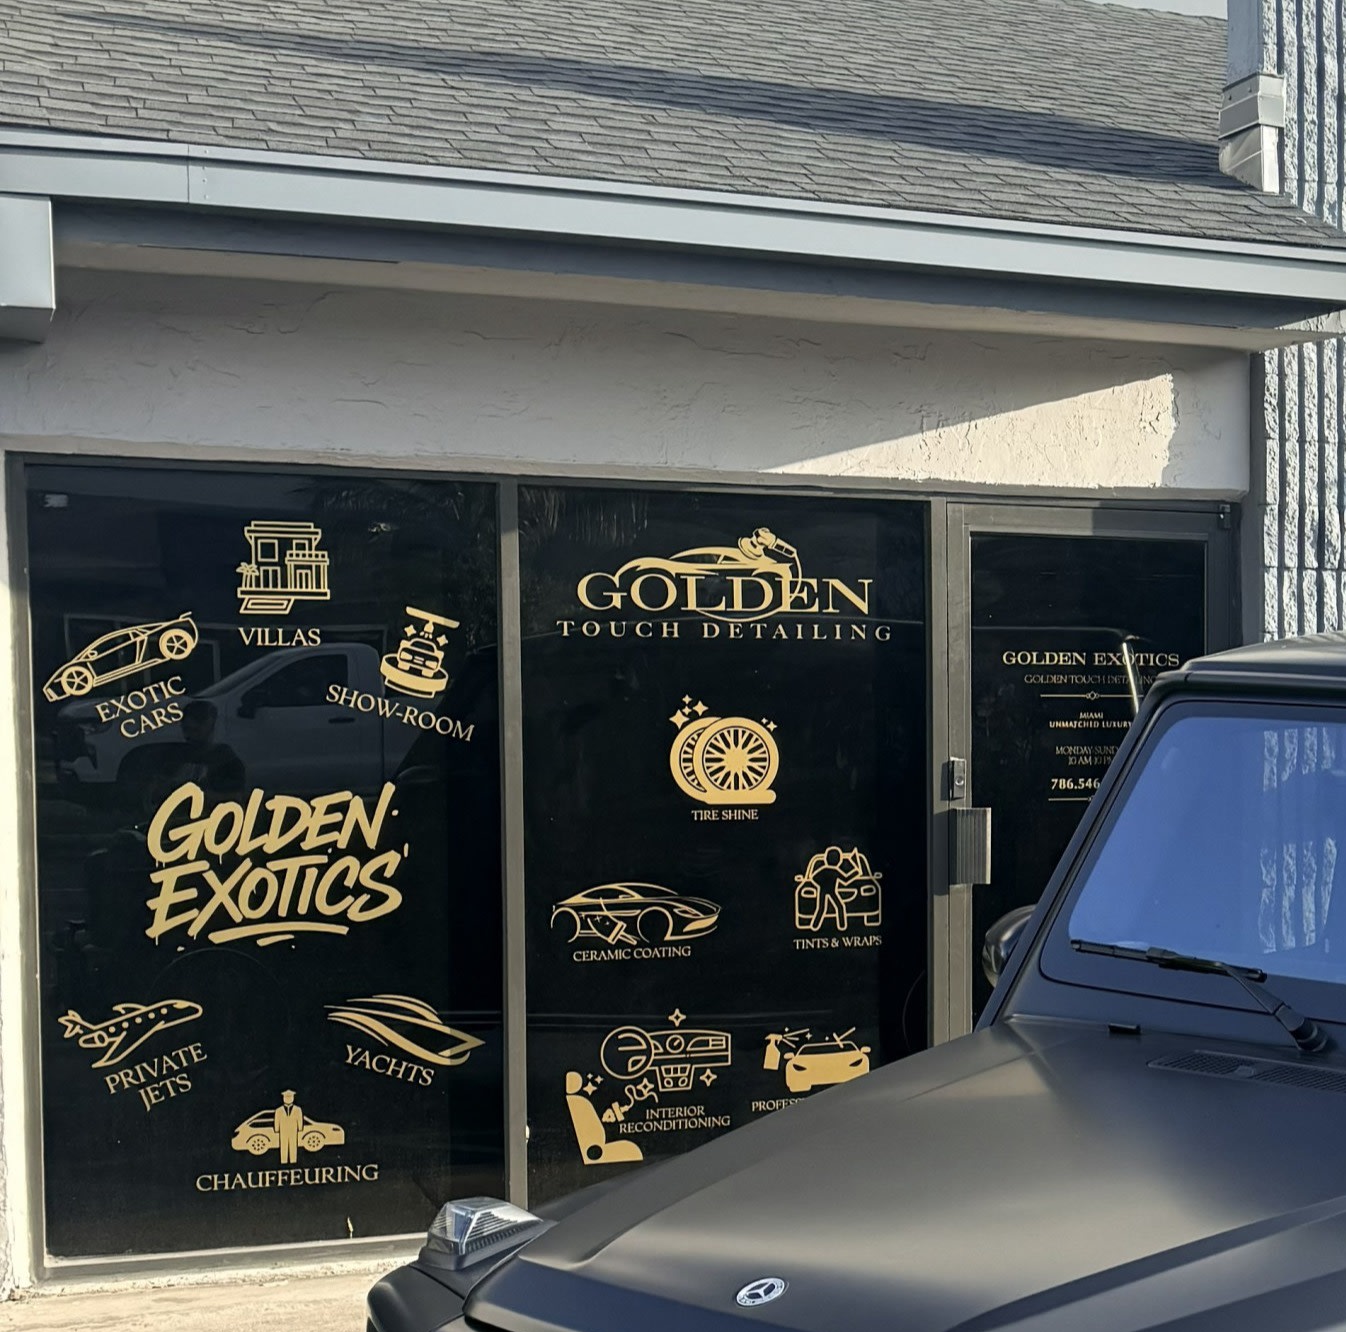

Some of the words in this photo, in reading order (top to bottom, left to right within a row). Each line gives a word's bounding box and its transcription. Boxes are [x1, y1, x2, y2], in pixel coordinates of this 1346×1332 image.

[576, 572, 873, 616] GOLDEN
[238, 627, 322, 647] VILLAS
[556, 620, 680, 639] TOUCH
[702, 622, 892, 641] DETAILING
[1002, 651, 1086, 666] GOLDEN
[1093, 652, 1180, 667] EXOTICS
[1024, 674, 1068, 684] GOLDEN
[1070, 674, 1106, 684] TOUCH
[95, 676, 187, 723] EXOTIC
[120, 702, 185, 739] CARS
[326, 684, 475, 742] SHOW-ROOM
[1049, 720, 1100, 729] UNMATCHED
[1051, 778, 1101, 790] 786.546
[148, 782, 396, 866] GOLDEN
[691, 809, 719, 822] TIRE
[721, 809, 759, 822] SHINE
[146, 854, 404, 942] EXOTICS
[793, 938, 829, 950] TINTS
[831, 937, 840, 948] &
[842, 935, 882, 947] WRAPS
[573, 948, 631, 962] CERAMIC
[633, 945, 692, 960] COATING
[104, 1043, 208, 1094] PRIVATE
[345, 1045, 434, 1086] YACHTS
[138, 1074, 192, 1112] JETS
[645, 1105, 705, 1119] INTERIOR
[619, 1116, 731, 1134] RECONDITIONING
[195, 1164, 380, 1191] CHAUFFEURING
